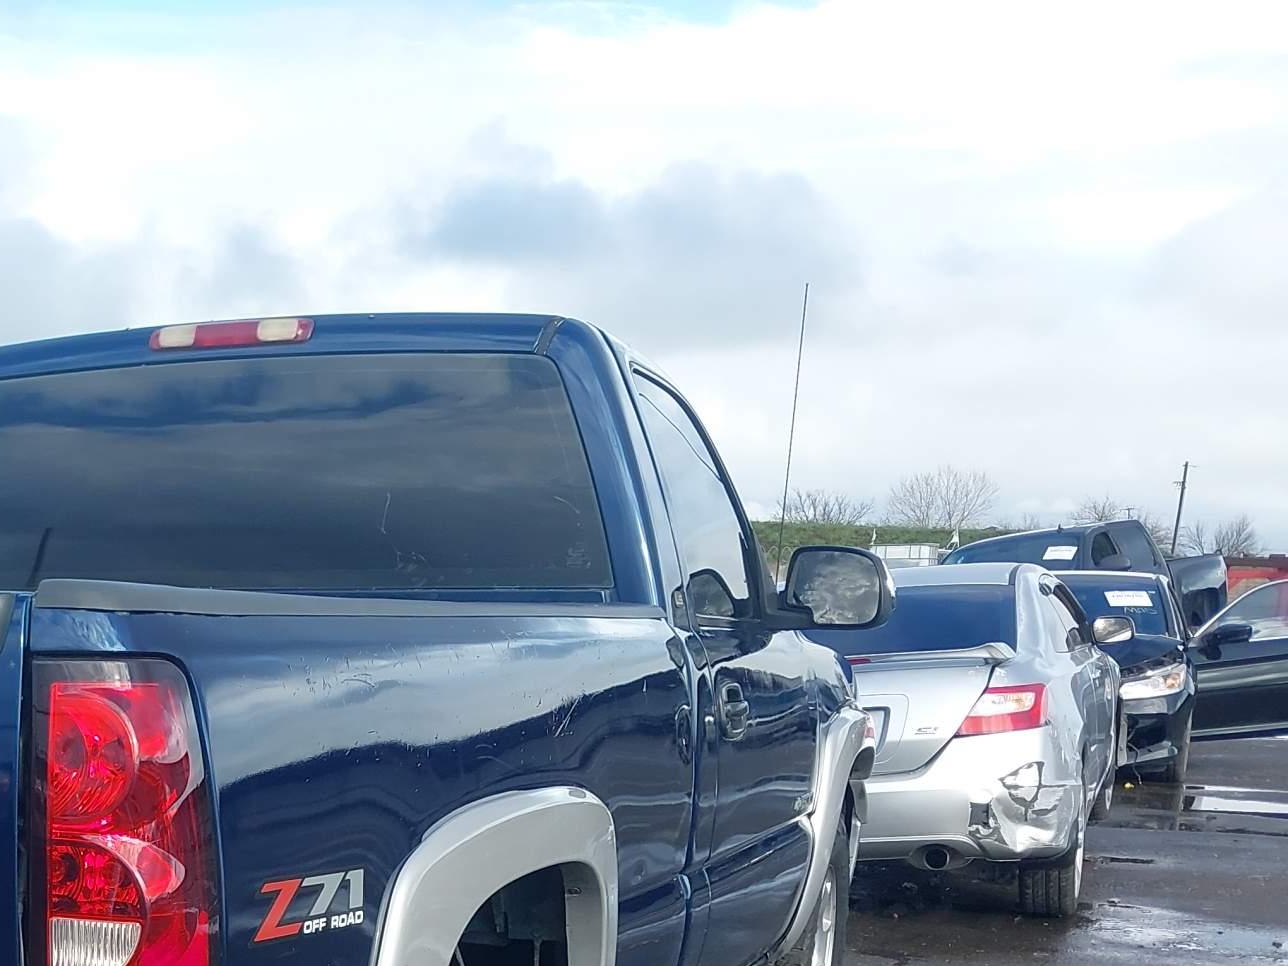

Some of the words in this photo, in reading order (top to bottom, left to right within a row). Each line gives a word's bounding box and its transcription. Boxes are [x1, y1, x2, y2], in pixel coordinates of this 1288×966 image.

[254, 868, 364, 942] Z71
[303, 918, 327, 934] OFF
[330, 911, 364, 929] ROAD
